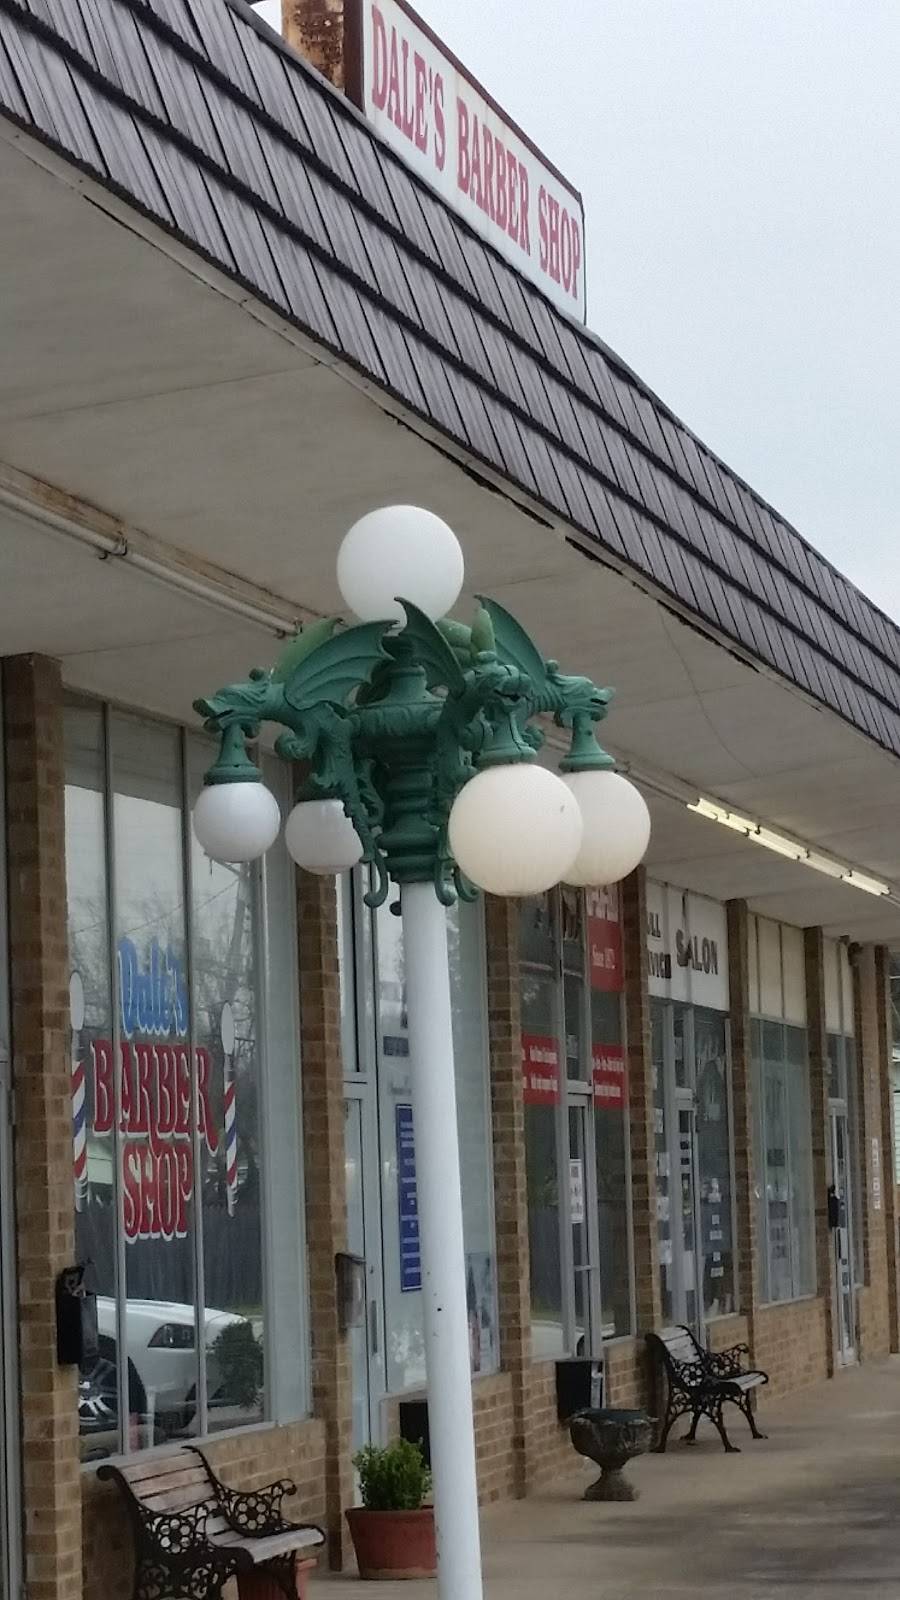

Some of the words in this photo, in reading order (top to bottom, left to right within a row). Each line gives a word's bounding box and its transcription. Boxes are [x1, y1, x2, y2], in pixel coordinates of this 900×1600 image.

[371, 3, 446, 173] DALE'S
[456, 95, 531, 257] BARBER
[538, 184, 581, 300] SHOP
[675, 928, 719, 976] SALON
[90, 1039, 219, 1157] BARBER
[122, 1144, 193, 1245] SHOP
